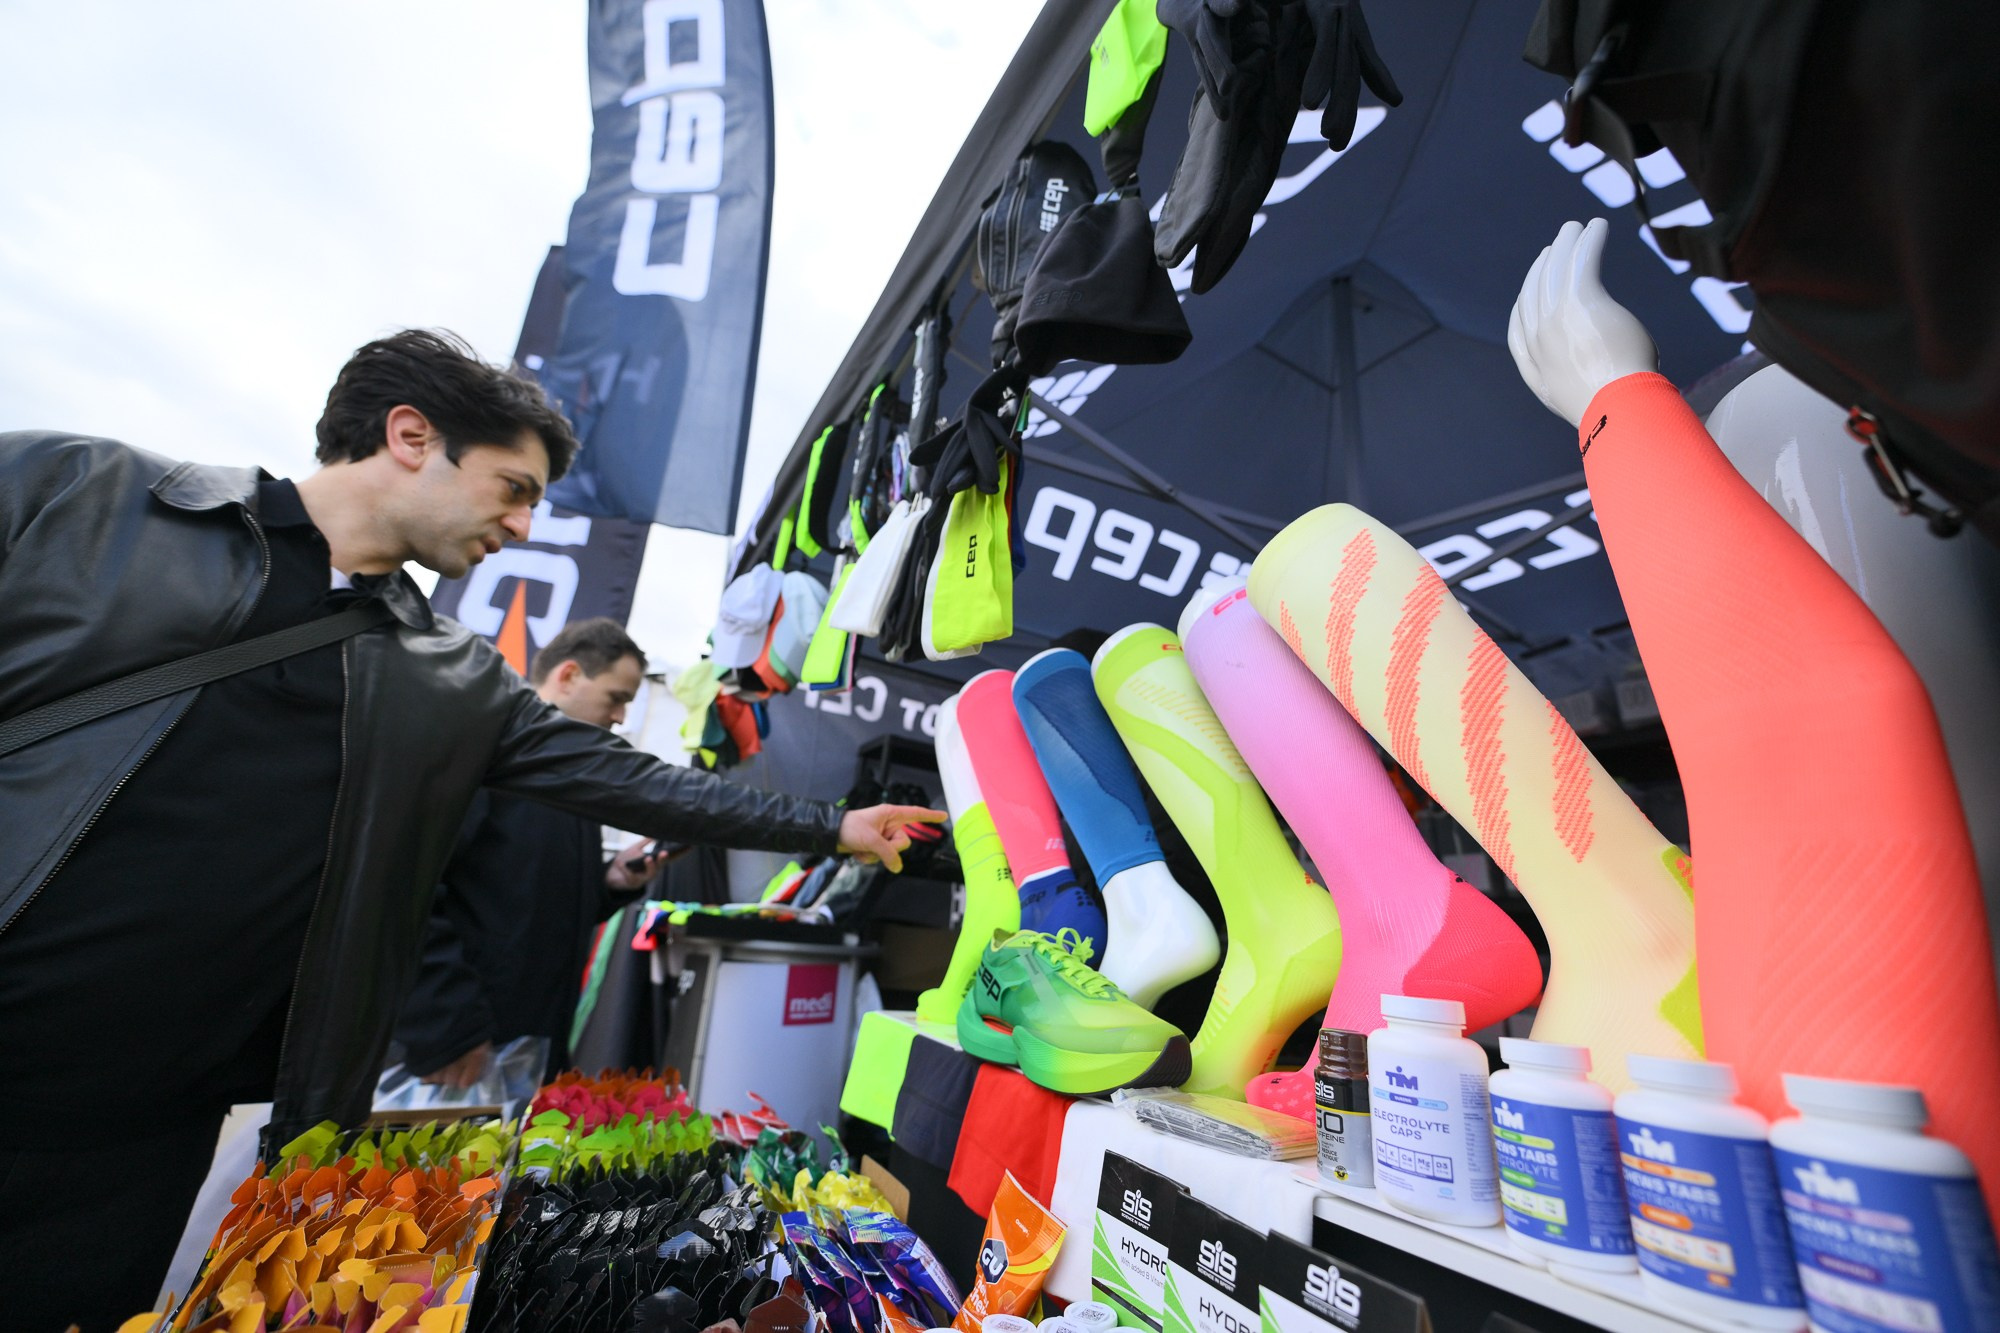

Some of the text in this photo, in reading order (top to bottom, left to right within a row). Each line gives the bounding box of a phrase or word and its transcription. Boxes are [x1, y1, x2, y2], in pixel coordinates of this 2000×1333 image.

[1042, 178, 1069, 213] cep
[966, 534, 977, 578] cep
[1374, 1107, 1450, 1134] ELECTROLYTE
[1390, 1125, 1422, 1140] CAPS
[1518, 1146, 1558, 1167] TABS
[981, 1247, 1004, 1276] GU
